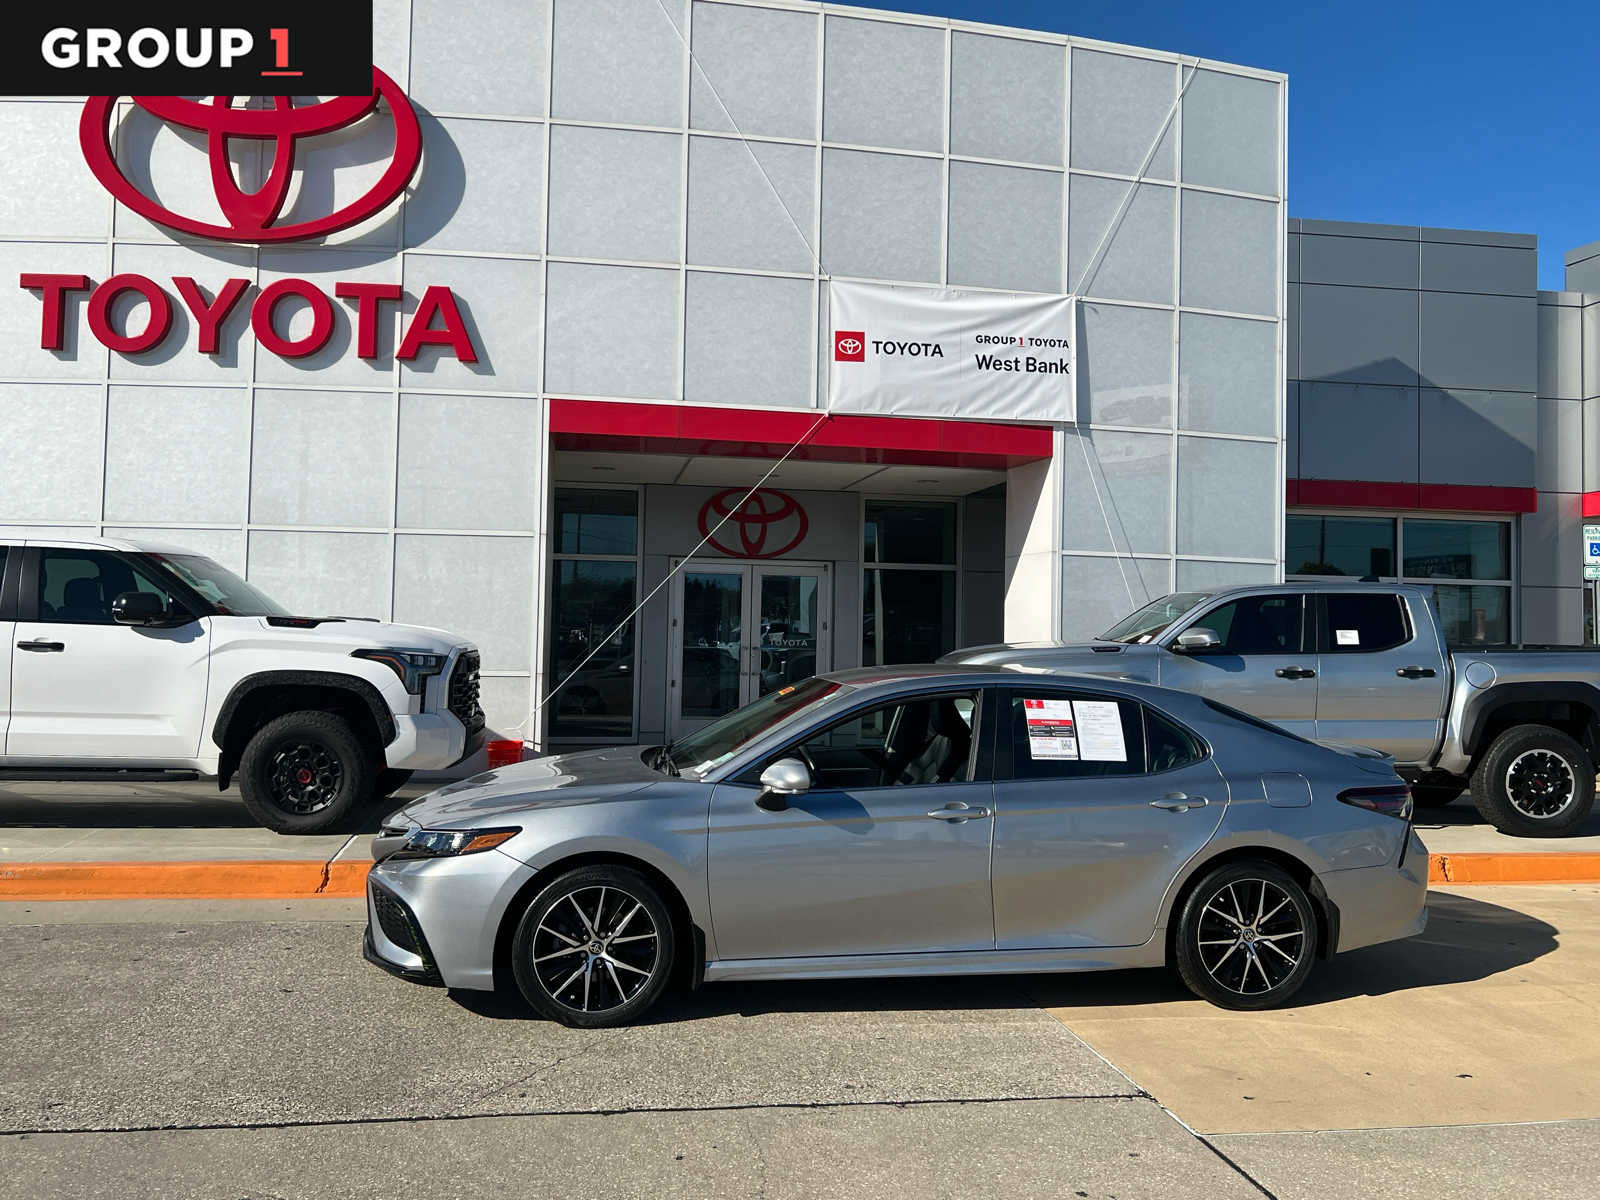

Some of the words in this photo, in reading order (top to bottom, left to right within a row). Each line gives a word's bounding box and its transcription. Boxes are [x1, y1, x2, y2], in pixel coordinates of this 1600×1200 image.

[20, 273, 477, 362] TOYOTA
[872, 341, 944, 358] TOYOTA
[975, 334, 1017, 345] GROUP
[1028, 337, 1070, 349] TOYOTA
[975, 354, 1020, 372] West
[1025, 356, 1070, 375] Bank
[769, 639, 808, 647] TOYOTA
